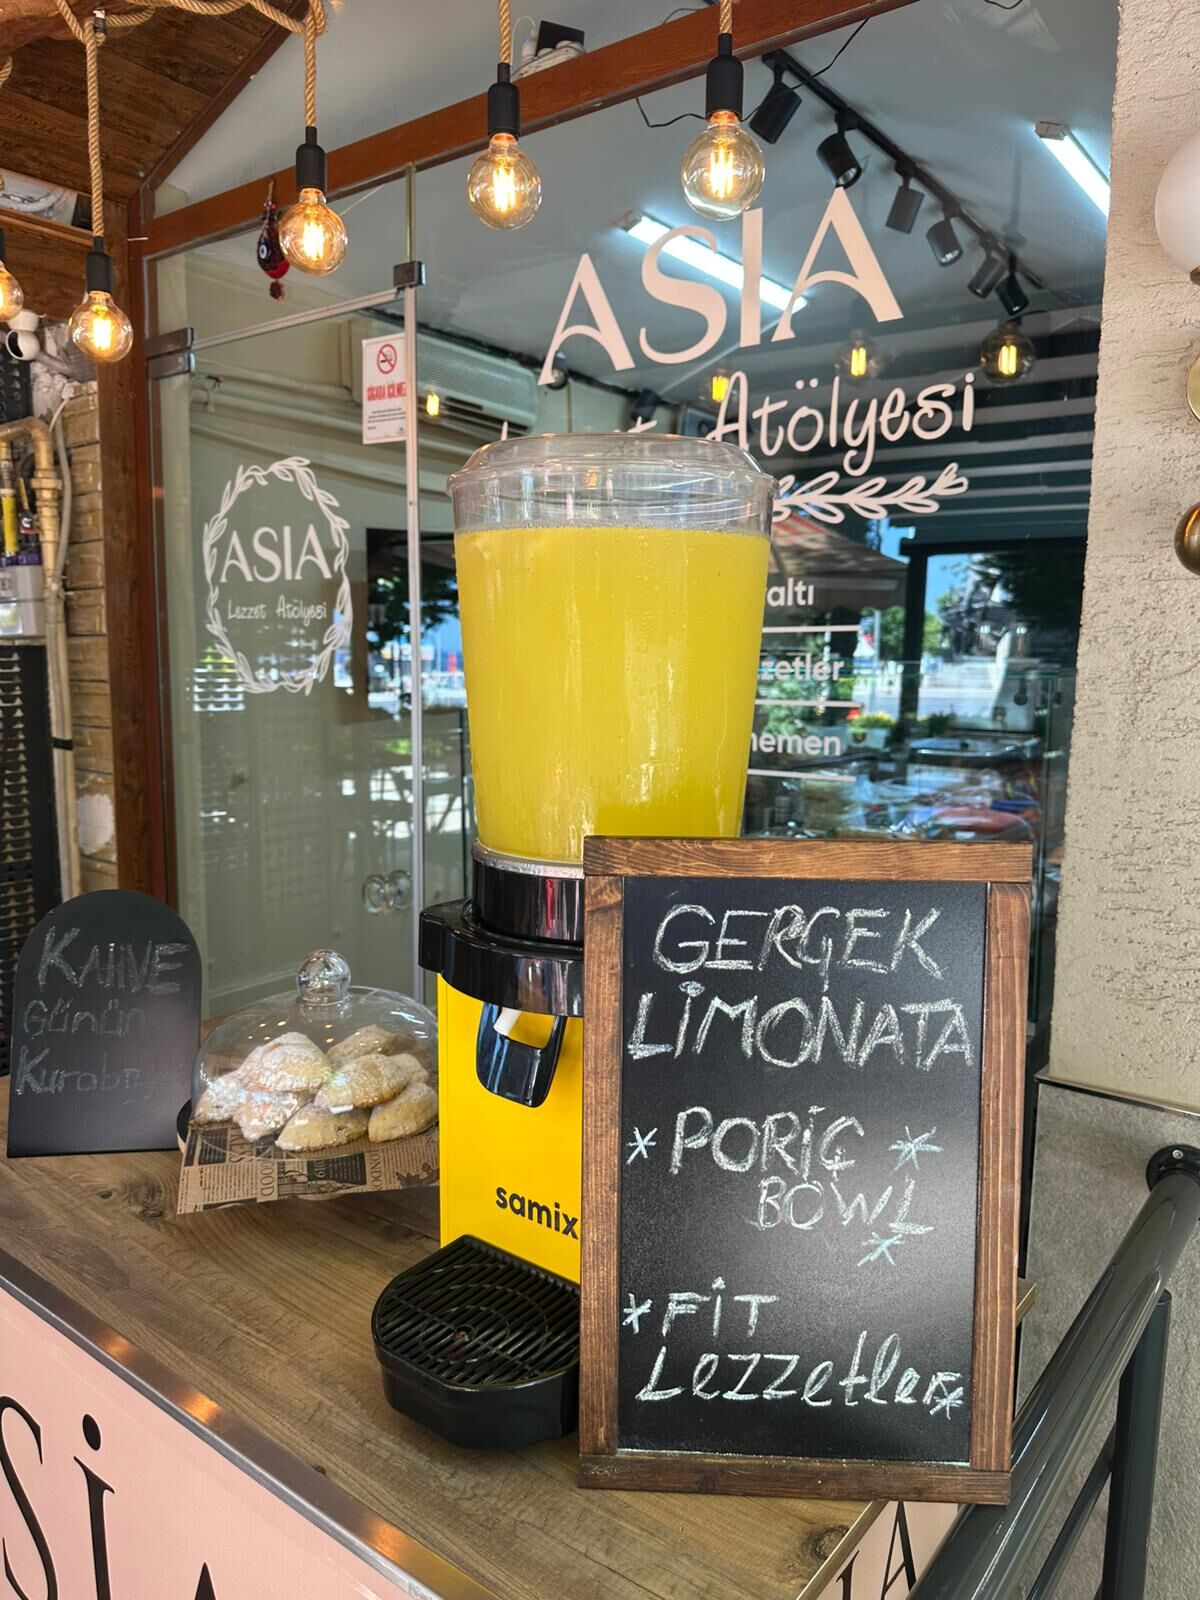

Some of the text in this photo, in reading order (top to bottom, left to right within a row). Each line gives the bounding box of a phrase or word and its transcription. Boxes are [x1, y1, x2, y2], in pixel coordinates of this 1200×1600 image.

[537, 187, 904, 386] ASIA
[706, 371, 974, 476] Atölyesi
[220, 524, 332, 583] ASIA
[228, 595, 327, 627] Lezzet Atölyesi
[766, 577, 815, 607] altı
[758, 653, 845, 681] zetler
[496, 1187, 578, 1240] samix
[748, 1176, 936, 1235] BOWL
